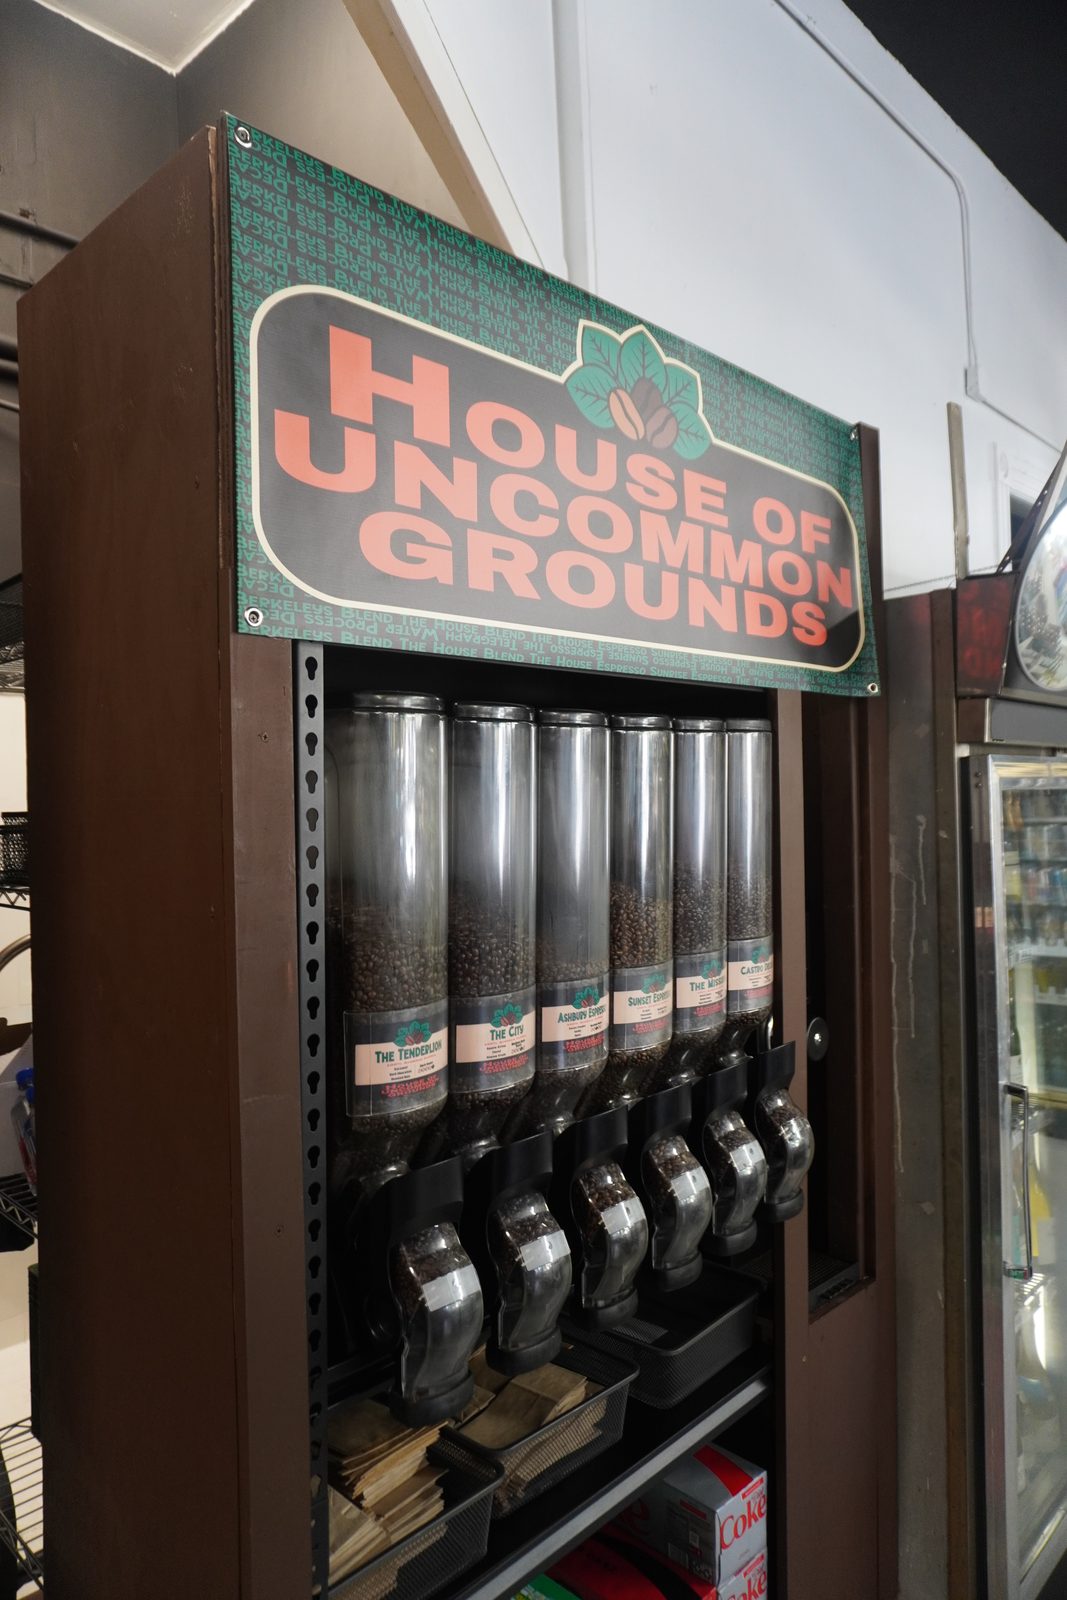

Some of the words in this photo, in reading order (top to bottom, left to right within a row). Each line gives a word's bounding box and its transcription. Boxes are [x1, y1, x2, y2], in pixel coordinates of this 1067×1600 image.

[329, 325, 727, 529] HOUSE
[753, 496, 831, 554] OF
[275, 410, 853, 609] UNCOMMON
[359, 511, 827, 647] GROUNDS
[341, 630, 392, 647] BLEND
[433, 640, 477, 656] HOUSE
[690, 981, 705, 992] THE
[627, 995, 652, 1007] SUNSET
[558, 1011, 588, 1024] ASHBURY
[490, 1029, 506, 1041] THE
[508, 1025, 524, 1037] CITY
[375, 1050, 395, 1064] THE
[720, 1494, 767, 1550] Coke
